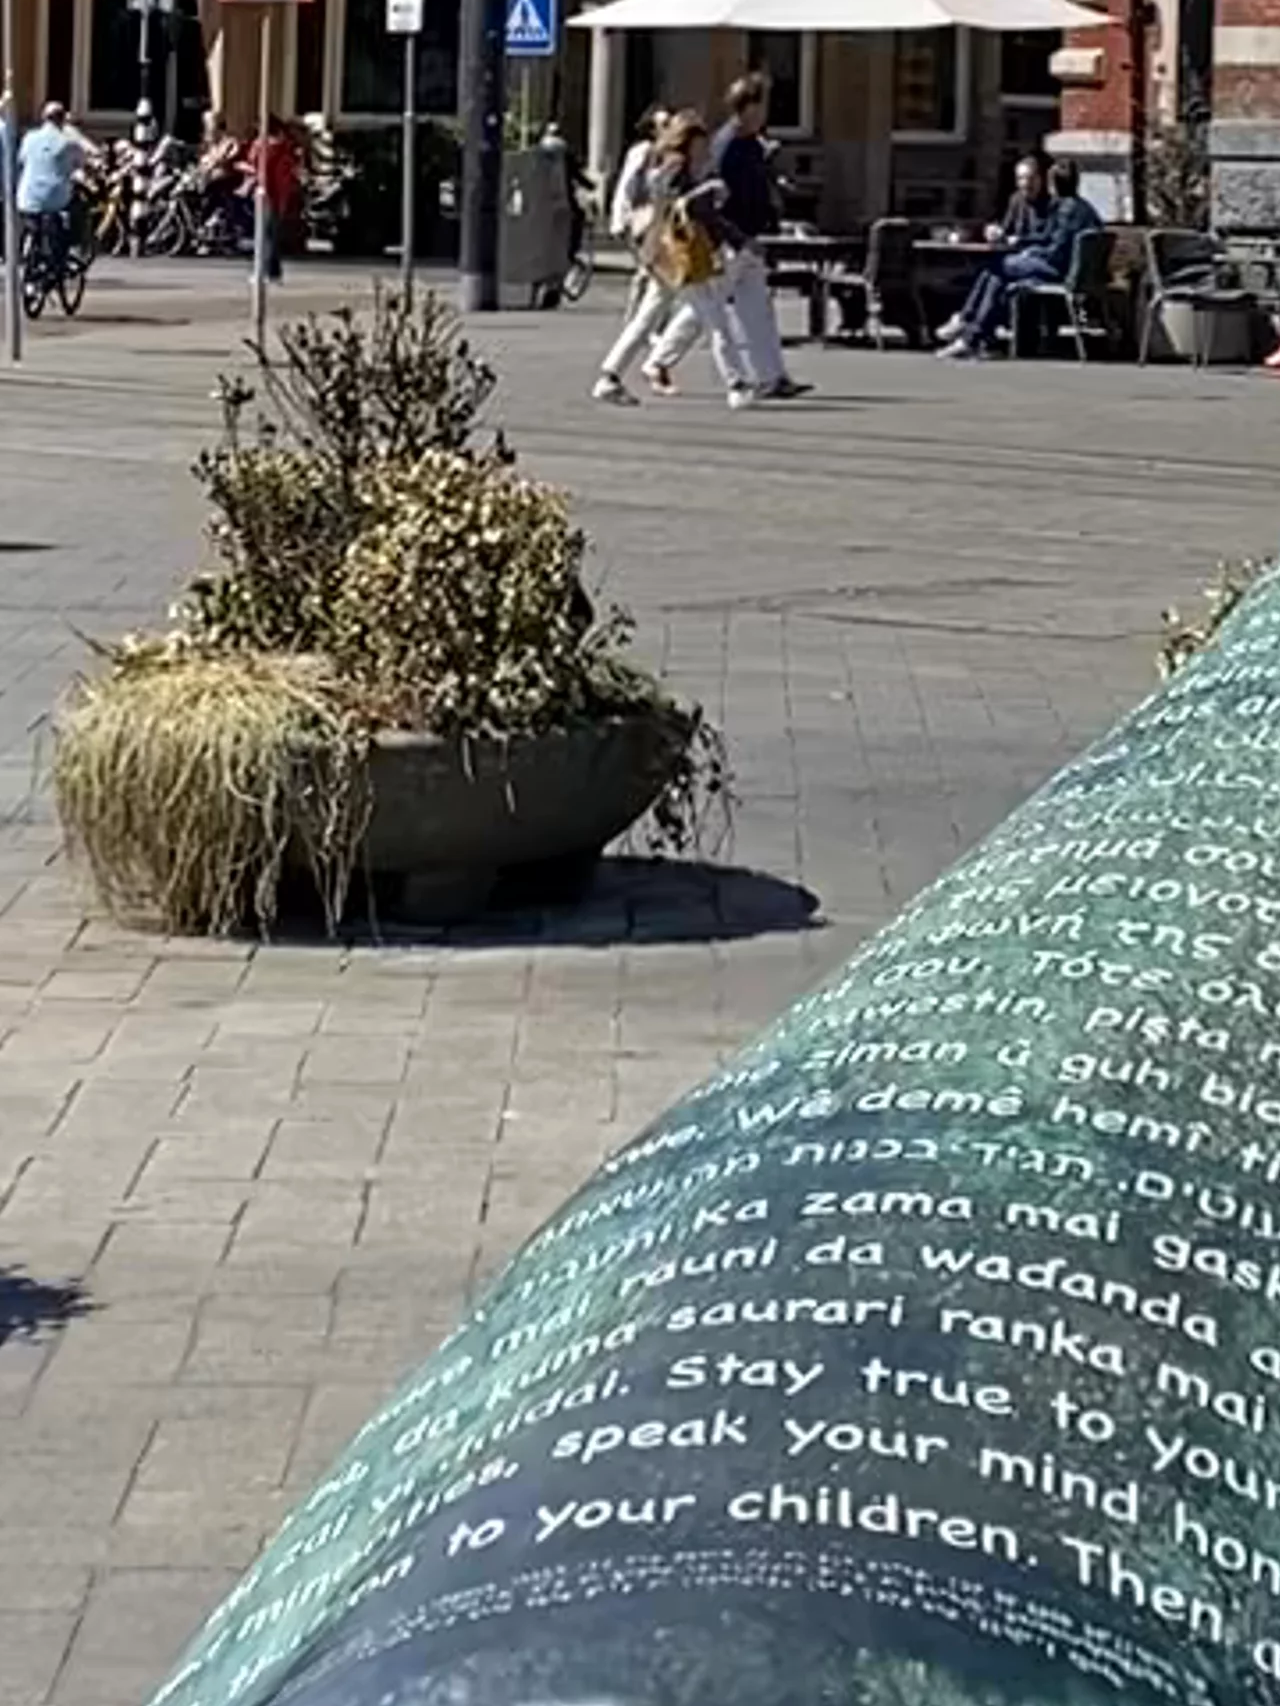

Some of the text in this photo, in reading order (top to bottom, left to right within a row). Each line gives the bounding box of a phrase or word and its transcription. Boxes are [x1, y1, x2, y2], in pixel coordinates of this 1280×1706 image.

[800, 1190, 973, 1223] zama
[1006, 1203, 1121, 1243] mai
[804, 1234, 885, 1267] da
[665, 1293, 907, 1333] saurari
[939, 1305, 1127, 1376] ranka
[1156, 1360, 1270, 1432] mai
[666, 1353, 825, 1396] Stay
[861, 1357, 1013, 1417] true
[1050, 1390, 1117, 1444] to
[551, 1410, 749, 1464] speak
[785, 1417, 950, 1463] your
[979, 1444, 1142, 1525] mind
[447, 1516, 506, 1558] to
[534, 1490, 697, 1543] your
[726, 1482, 1040, 1570] children.
[1060, 1533, 1226, 1644] Then
